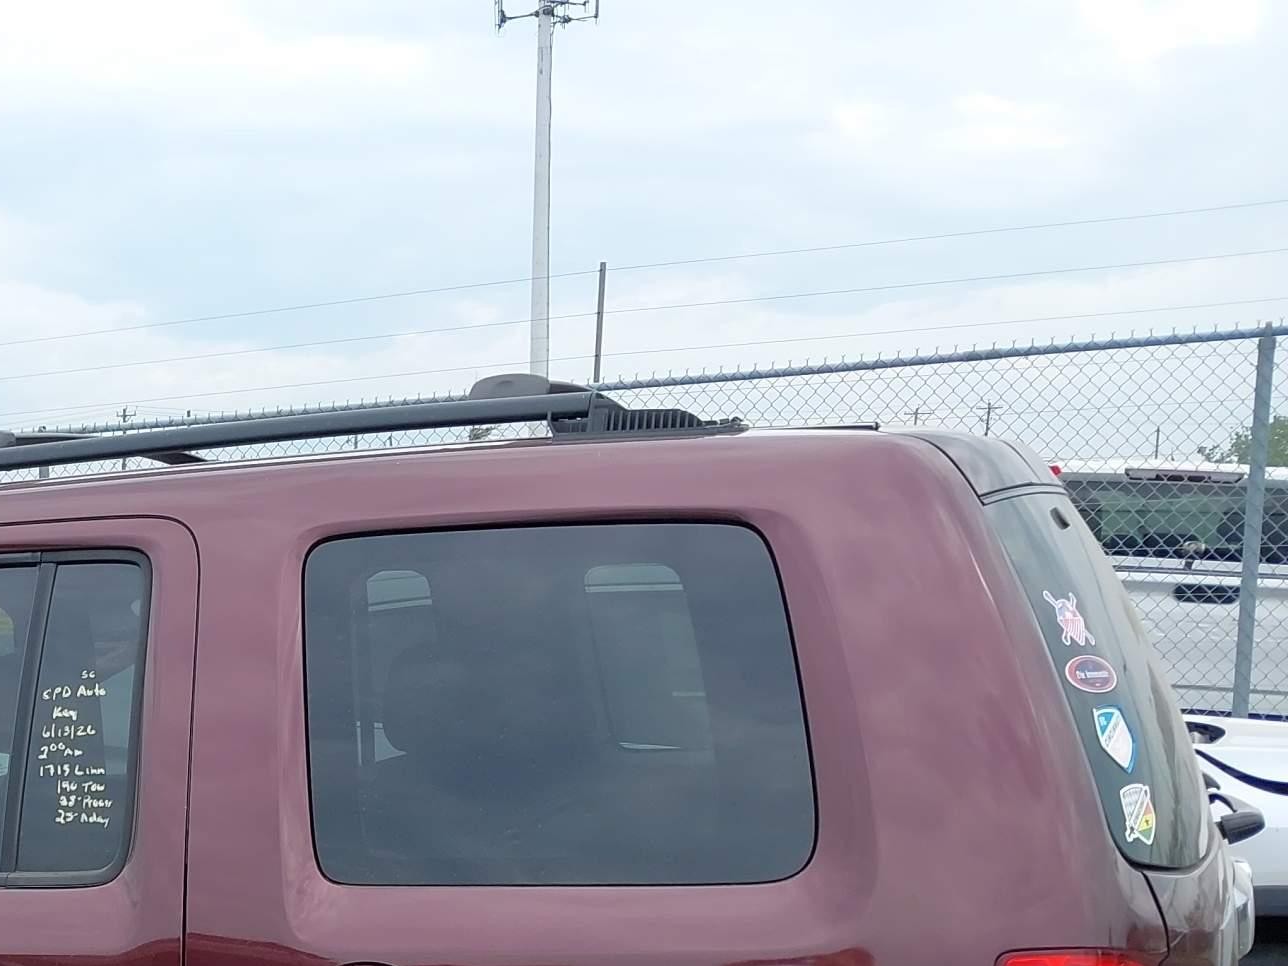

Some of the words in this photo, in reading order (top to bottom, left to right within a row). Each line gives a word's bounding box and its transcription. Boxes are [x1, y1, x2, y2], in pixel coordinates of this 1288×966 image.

[77, 683, 107, 698] Auto
[52, 706, 78, 721] Key
[42, 723, 96, 740] 6/13/26
[40, 764, 70, 777] 1715
